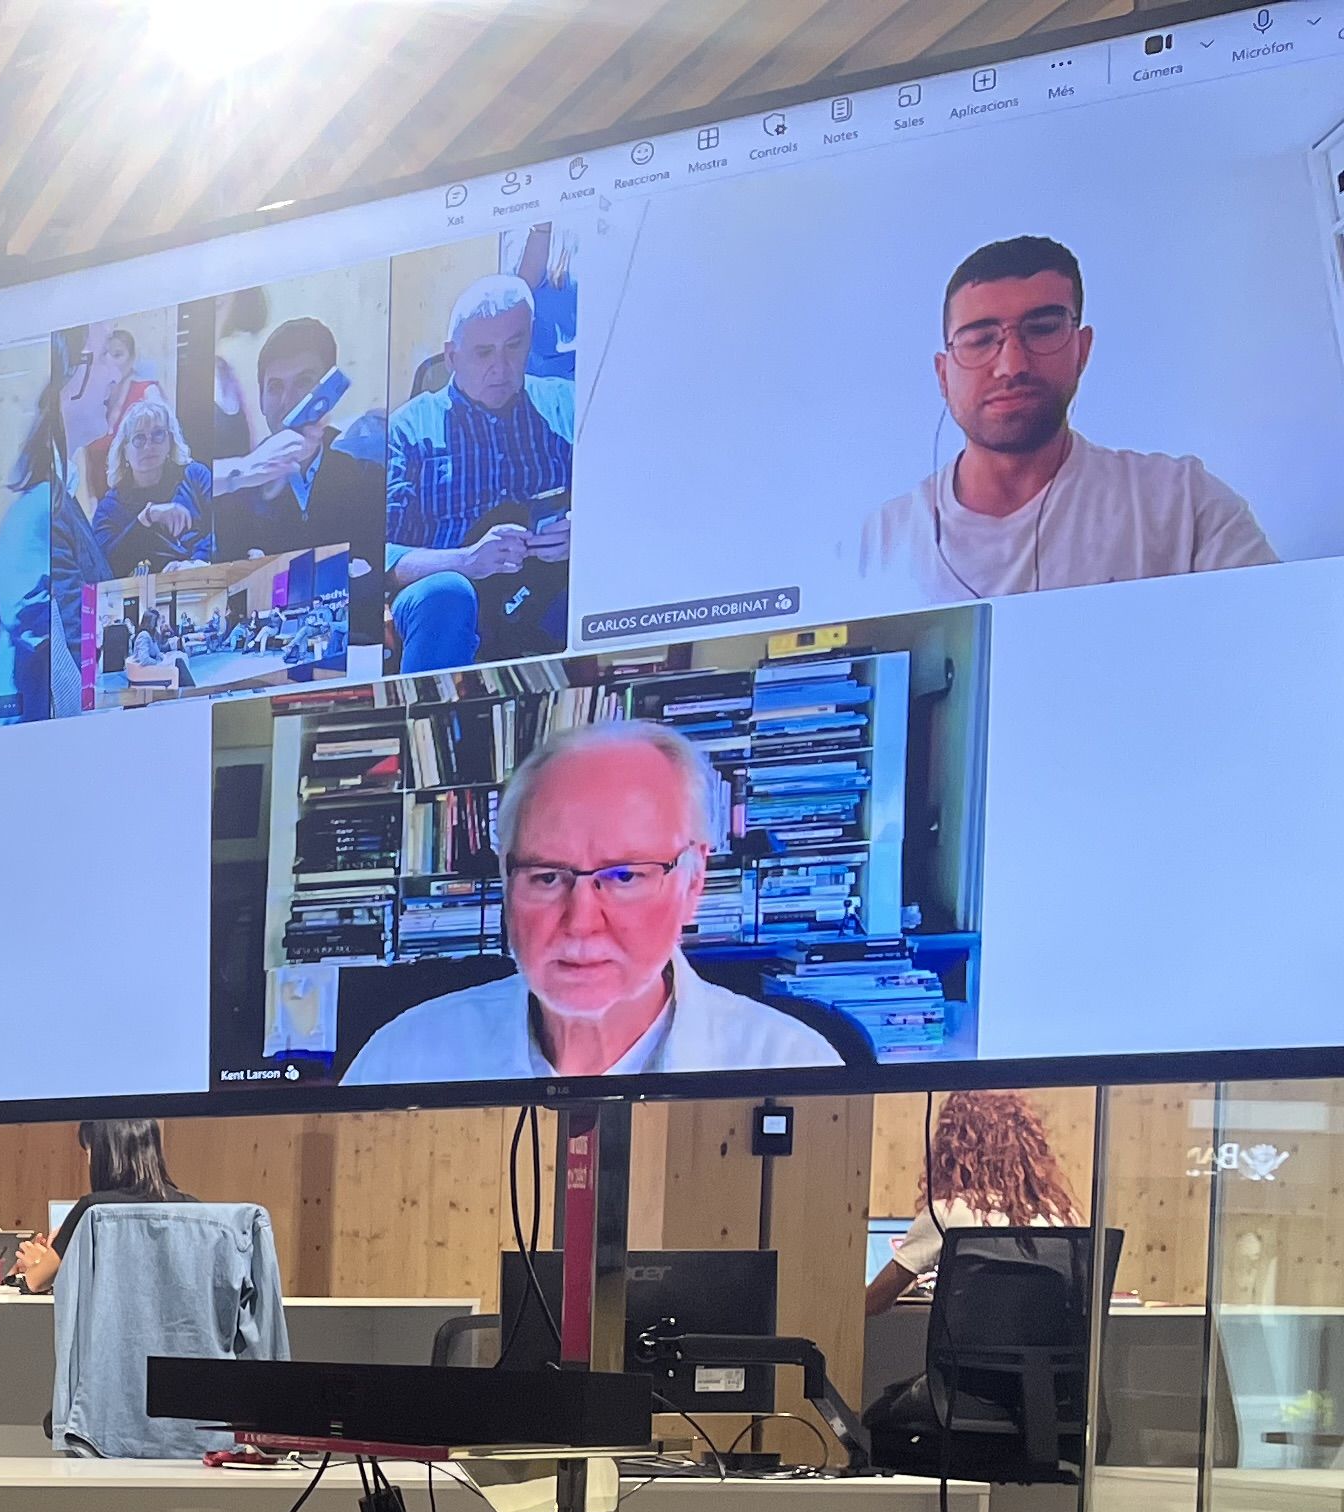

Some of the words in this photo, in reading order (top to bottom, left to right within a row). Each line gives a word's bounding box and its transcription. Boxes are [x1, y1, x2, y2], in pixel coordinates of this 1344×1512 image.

[949, 96, 1020, 120] Aplicacions
[894, 115, 925, 131] Sales
[823, 128, 859, 145] Notes
[749, 141, 798, 160] Controls
[688, 158, 728, 174] Mostra
[614, 170, 670, 189] Reacciona
[559, 187, 595, 202] Aixeca
[447, 215, 464, 227] Xat
[587, 616, 637, 634] CARLOS
[639, 606, 708, 627] CAYETANO
[711, 598, 769, 617] ROBINAT
[220, 1070, 245, 1080] Kent
[246, 1069, 281, 1080] Larson
